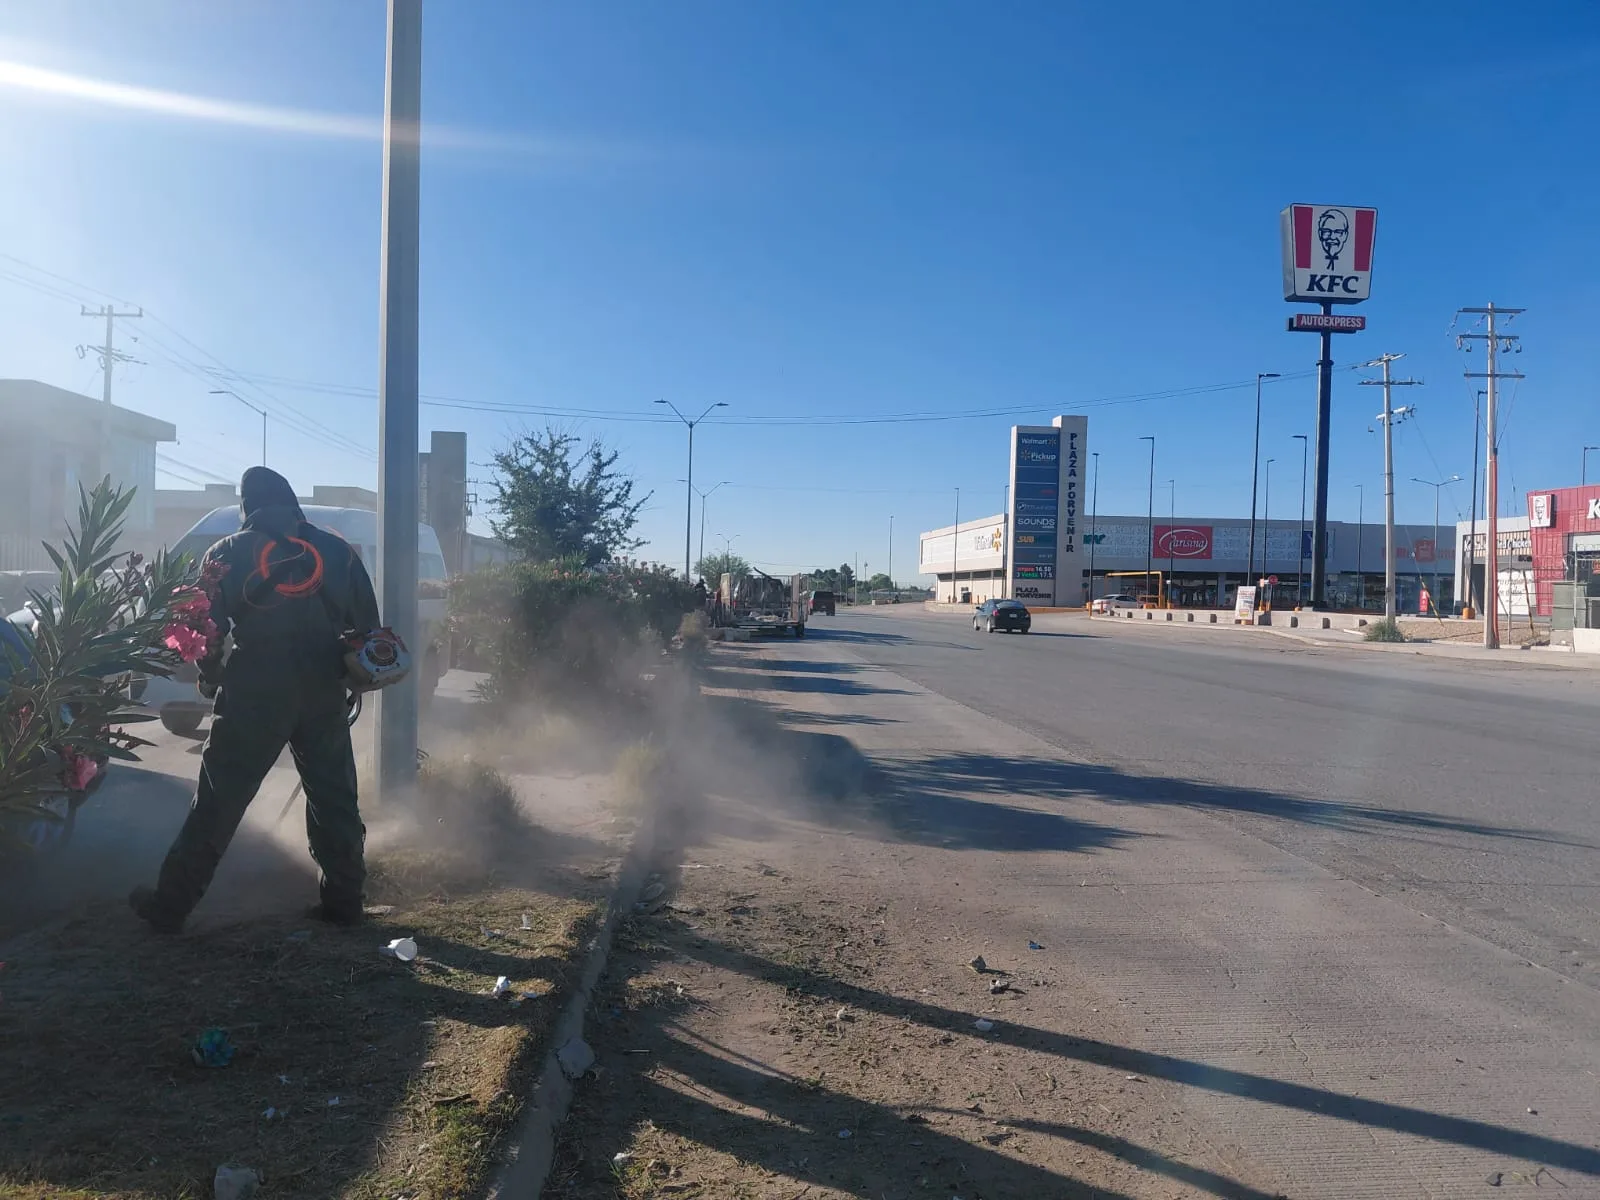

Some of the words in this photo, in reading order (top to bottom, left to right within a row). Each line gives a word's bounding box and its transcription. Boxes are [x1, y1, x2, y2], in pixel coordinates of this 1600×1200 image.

[1306, 274, 1359, 293] KFC
[1300, 315, 1362, 328] AUTOEXPRESS
[1021, 437, 1048, 445] Walmart
[1031, 452, 1056, 461] Pickup
[1068, 433, 1078, 477] PLAZA
[1017, 518, 1056, 526] SOUNDS
[1066, 482, 1076, 553] PORVENIR
